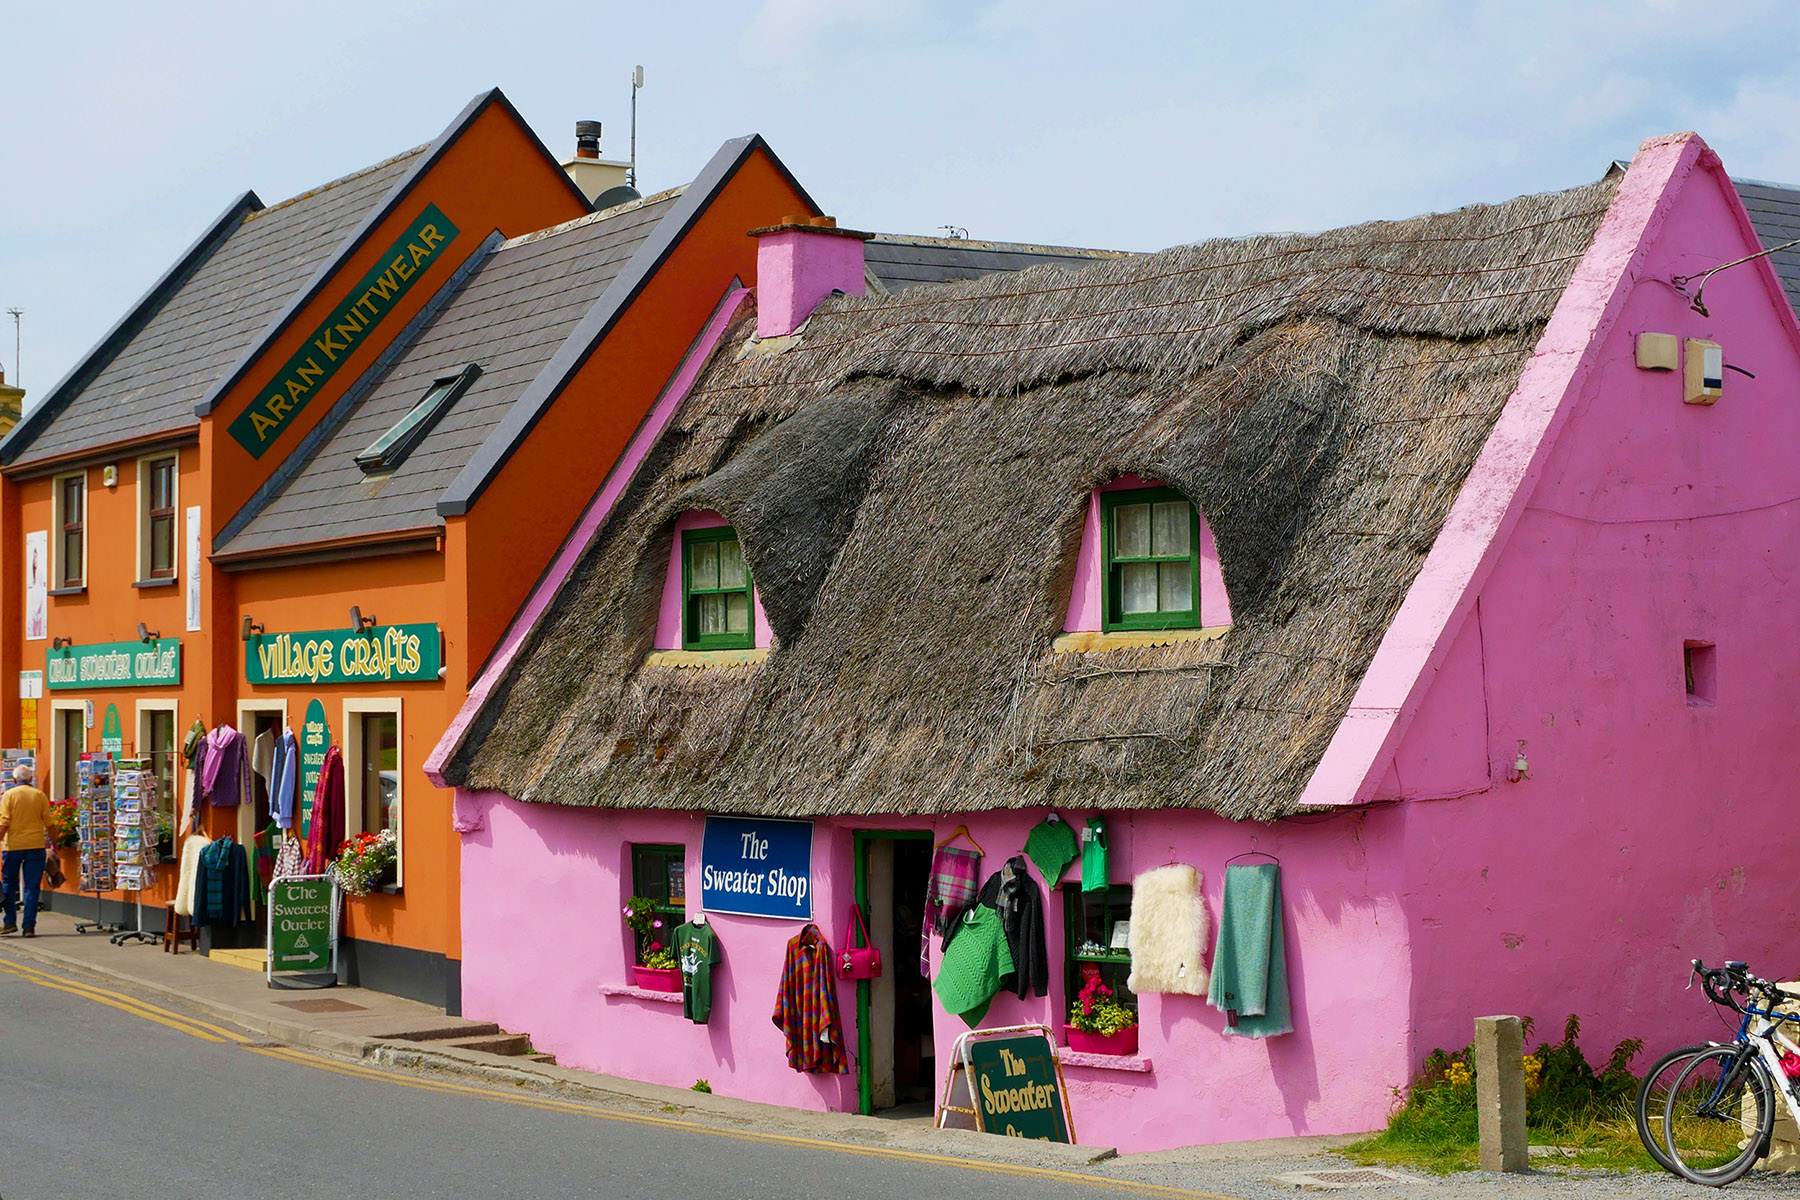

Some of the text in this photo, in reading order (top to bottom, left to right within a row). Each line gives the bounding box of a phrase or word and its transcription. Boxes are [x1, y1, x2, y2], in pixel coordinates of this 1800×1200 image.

[249, 223, 446, 442] ARAN KNITWEAR
[741, 831, 769, 860] The
[287, 886, 318, 901] The
[703, 865, 807, 906] Sweater Shop
[275, 904, 329, 916] Sweater
[280, 919, 325, 931] Outlet
[999, 1048, 1027, 1077] The
[981, 1073, 1056, 1115] Sweater
